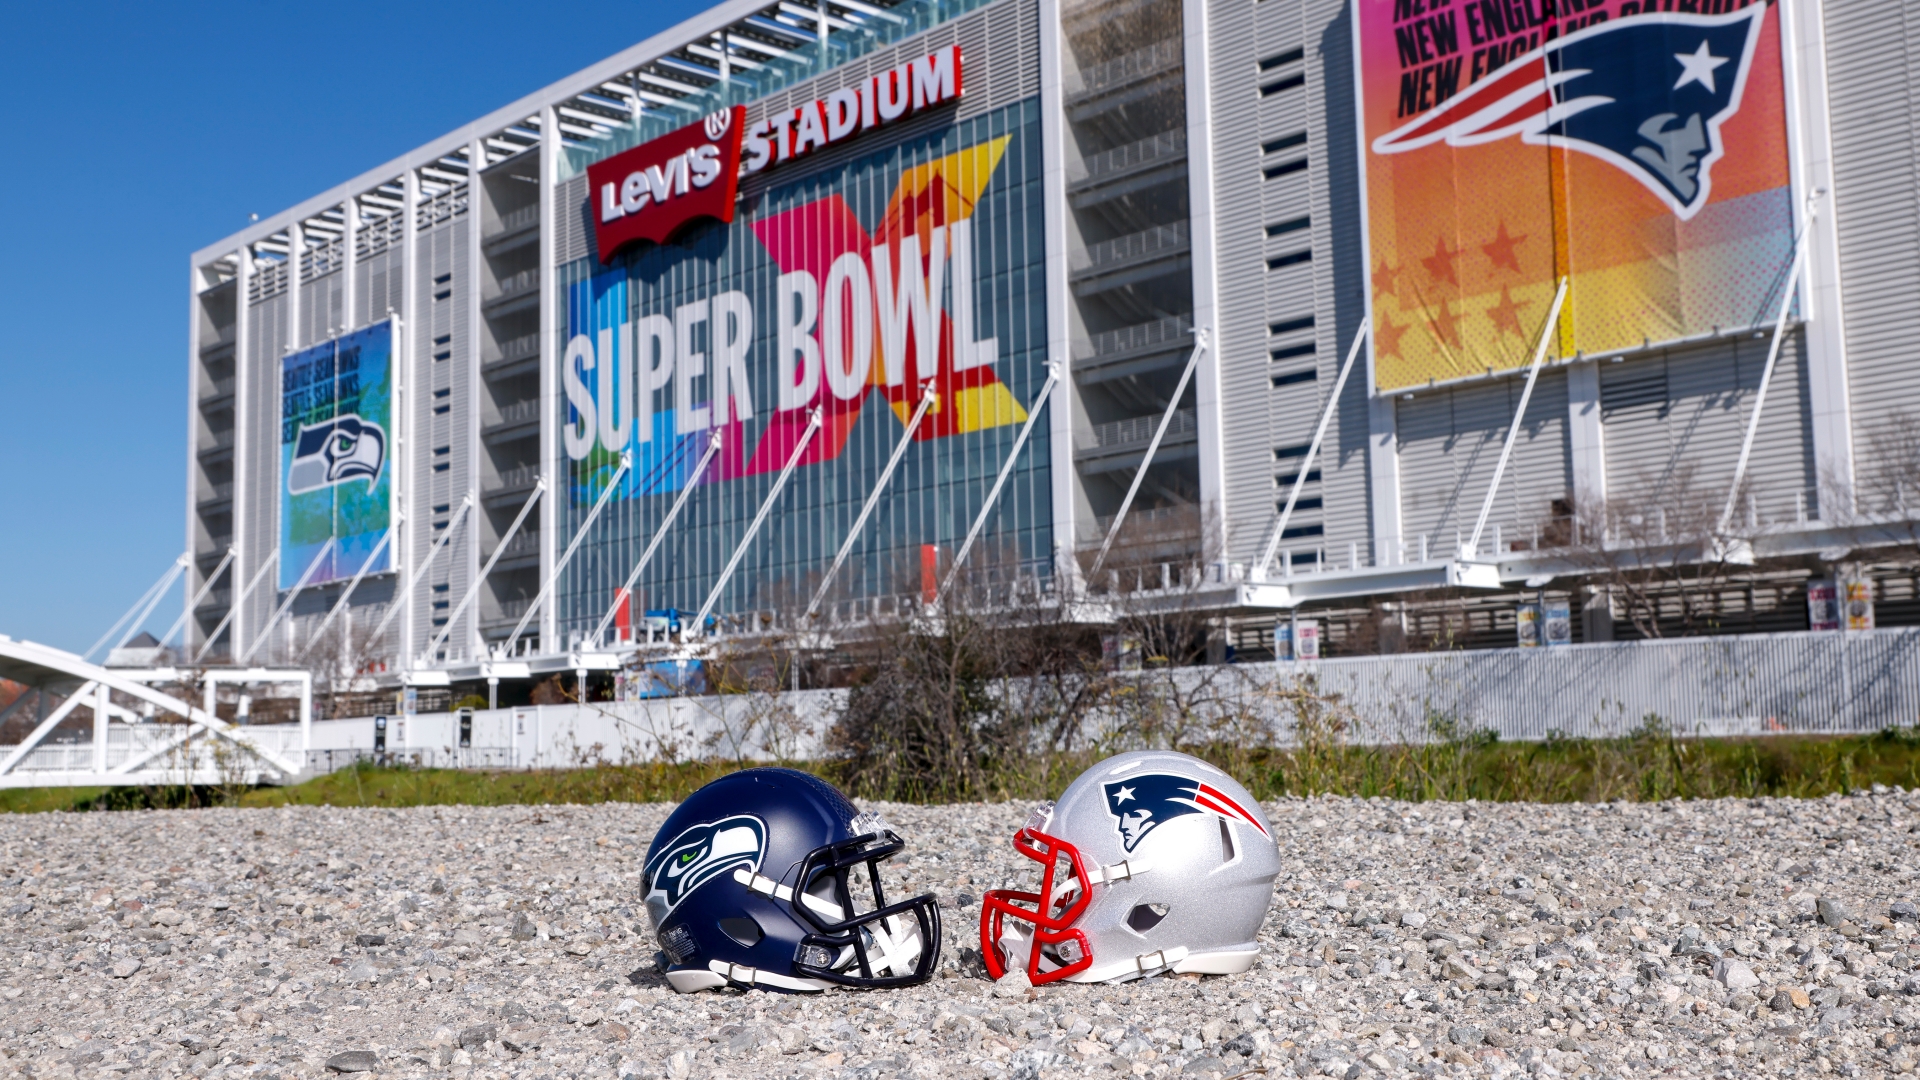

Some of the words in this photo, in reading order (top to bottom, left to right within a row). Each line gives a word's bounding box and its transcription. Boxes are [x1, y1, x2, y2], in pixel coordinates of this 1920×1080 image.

[1394, 9, 1459, 69] NEW
[747, 45, 961, 172] STADIUM
[1398, 56, 1463, 118] NEW
[563, 290, 754, 460] SUPER
[777, 217, 999, 412] BOWL
